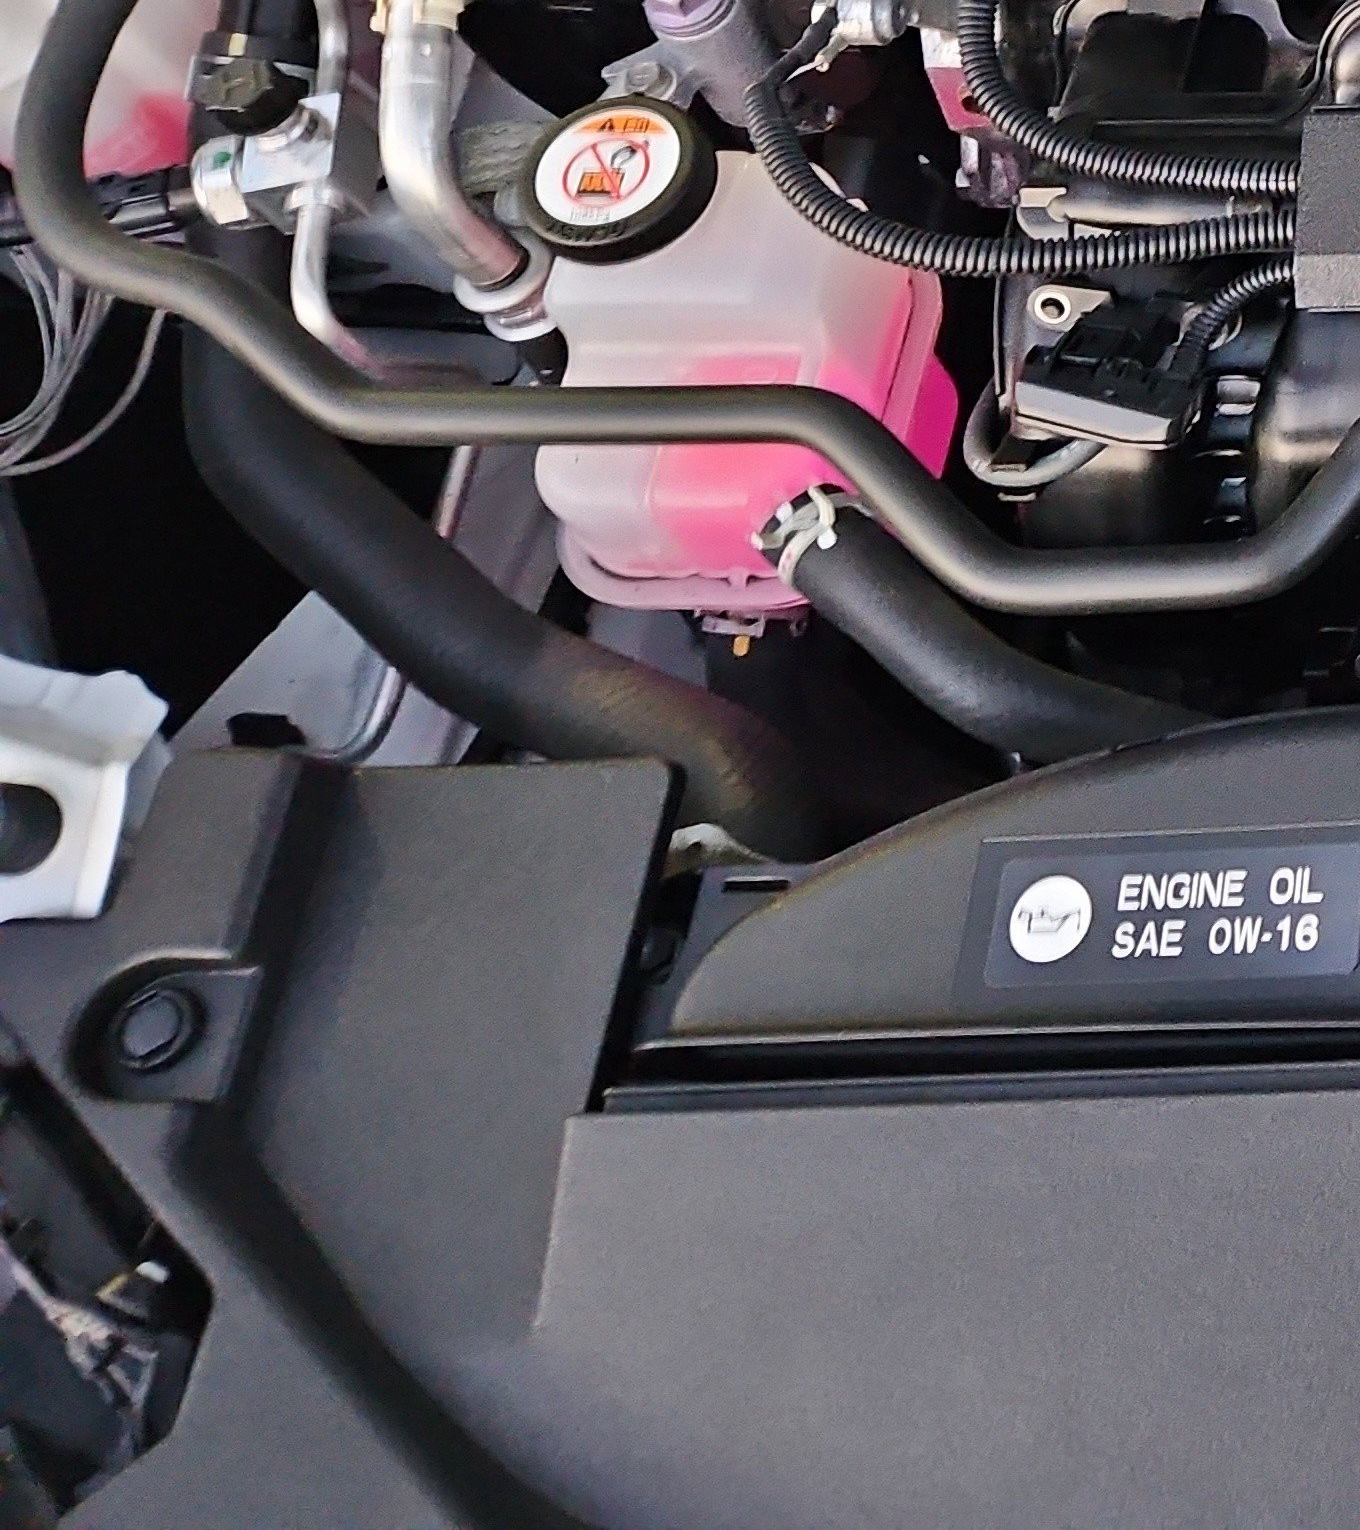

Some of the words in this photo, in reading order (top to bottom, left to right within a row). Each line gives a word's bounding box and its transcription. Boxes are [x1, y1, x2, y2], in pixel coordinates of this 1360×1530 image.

[1116, 868, 1249, 912] ENGINE
[1268, 866, 1324, 907] OIL
[1110, 918, 1187, 959] SAE
[1207, 913, 1320, 956] 0W-16
